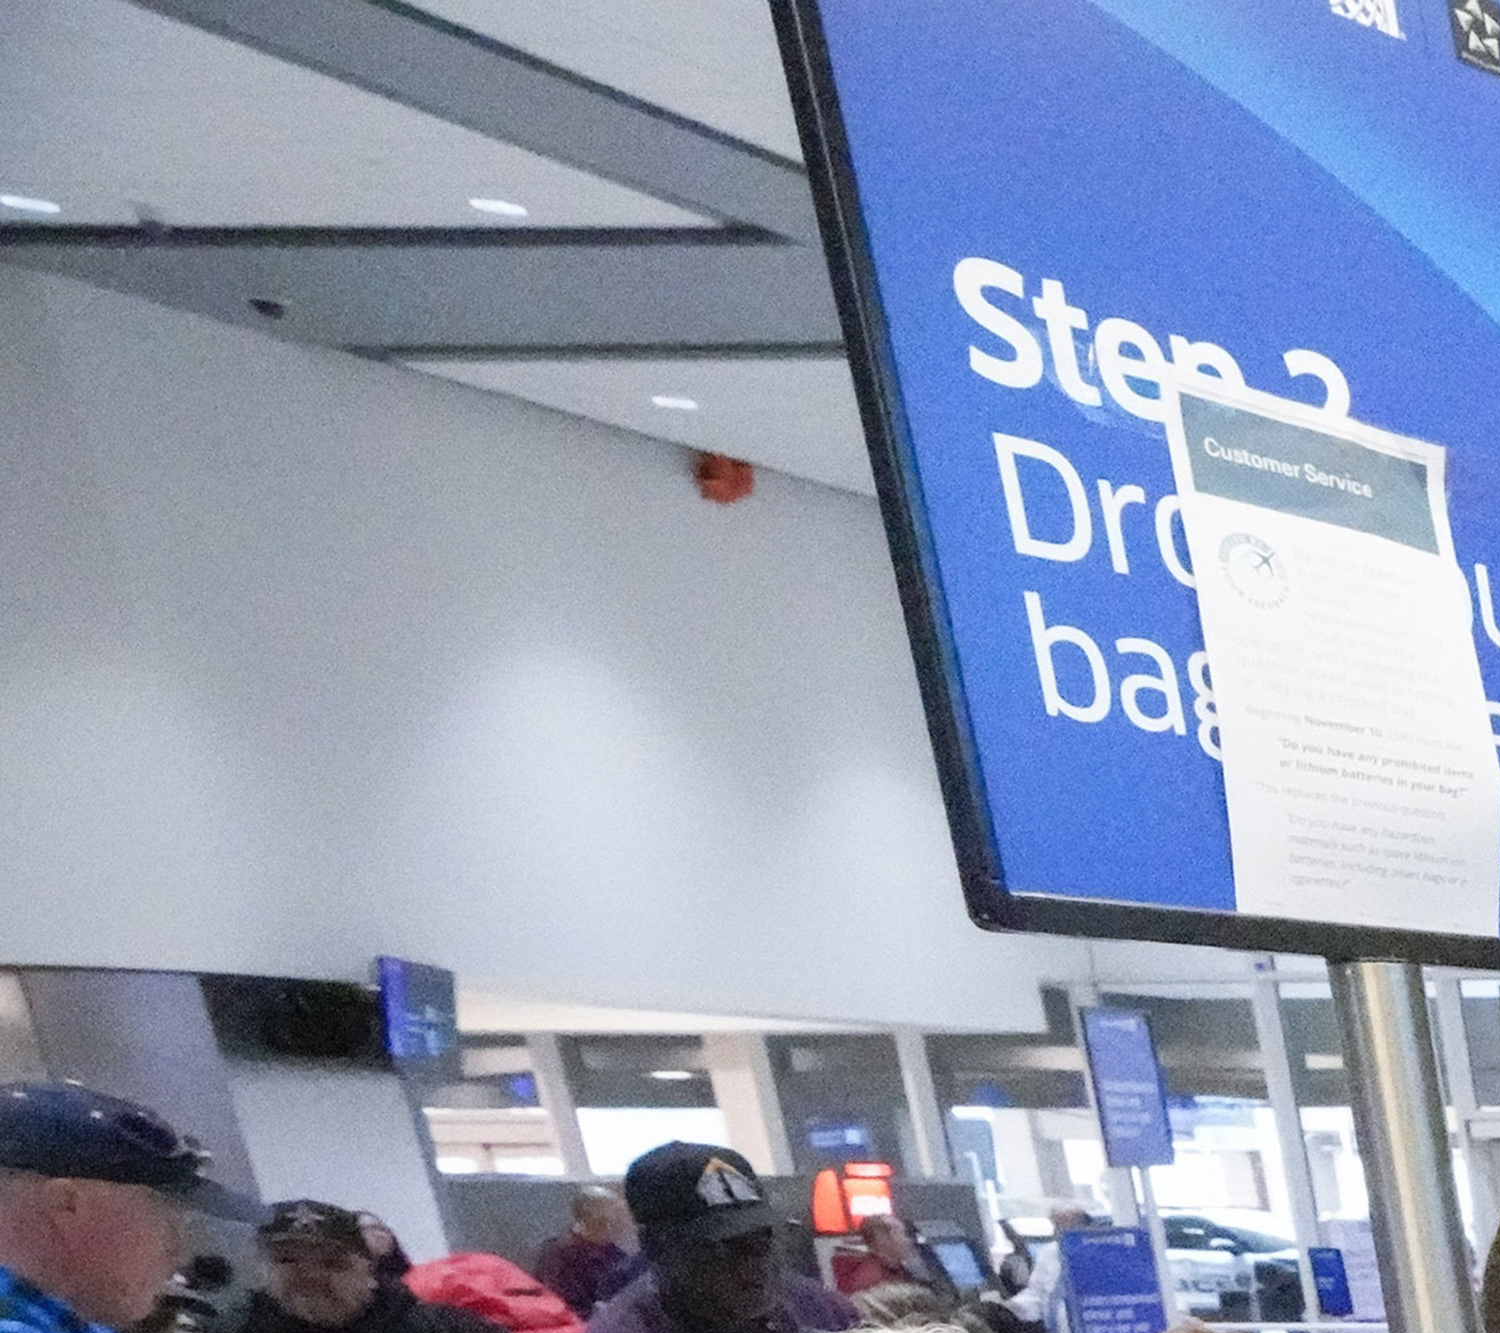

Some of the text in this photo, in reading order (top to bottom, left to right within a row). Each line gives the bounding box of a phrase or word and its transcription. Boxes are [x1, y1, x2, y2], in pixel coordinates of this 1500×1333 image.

[1203, 437, 1373, 498] Customer Service
[1304, 714, 1365, 734] November
[1279, 757, 1291, 769] or
[1295, 760, 1338, 776] lithium
[1341, 768, 1394, 786] batteries
[1396, 776, 1408, 787] in
[1410, 779, 1436, 793] your
[1302, 741, 1323, 755] you
[1326, 746, 1354, 761] have
[1357, 752, 1378, 767] any
[1381, 755, 1441, 775] prohibited
